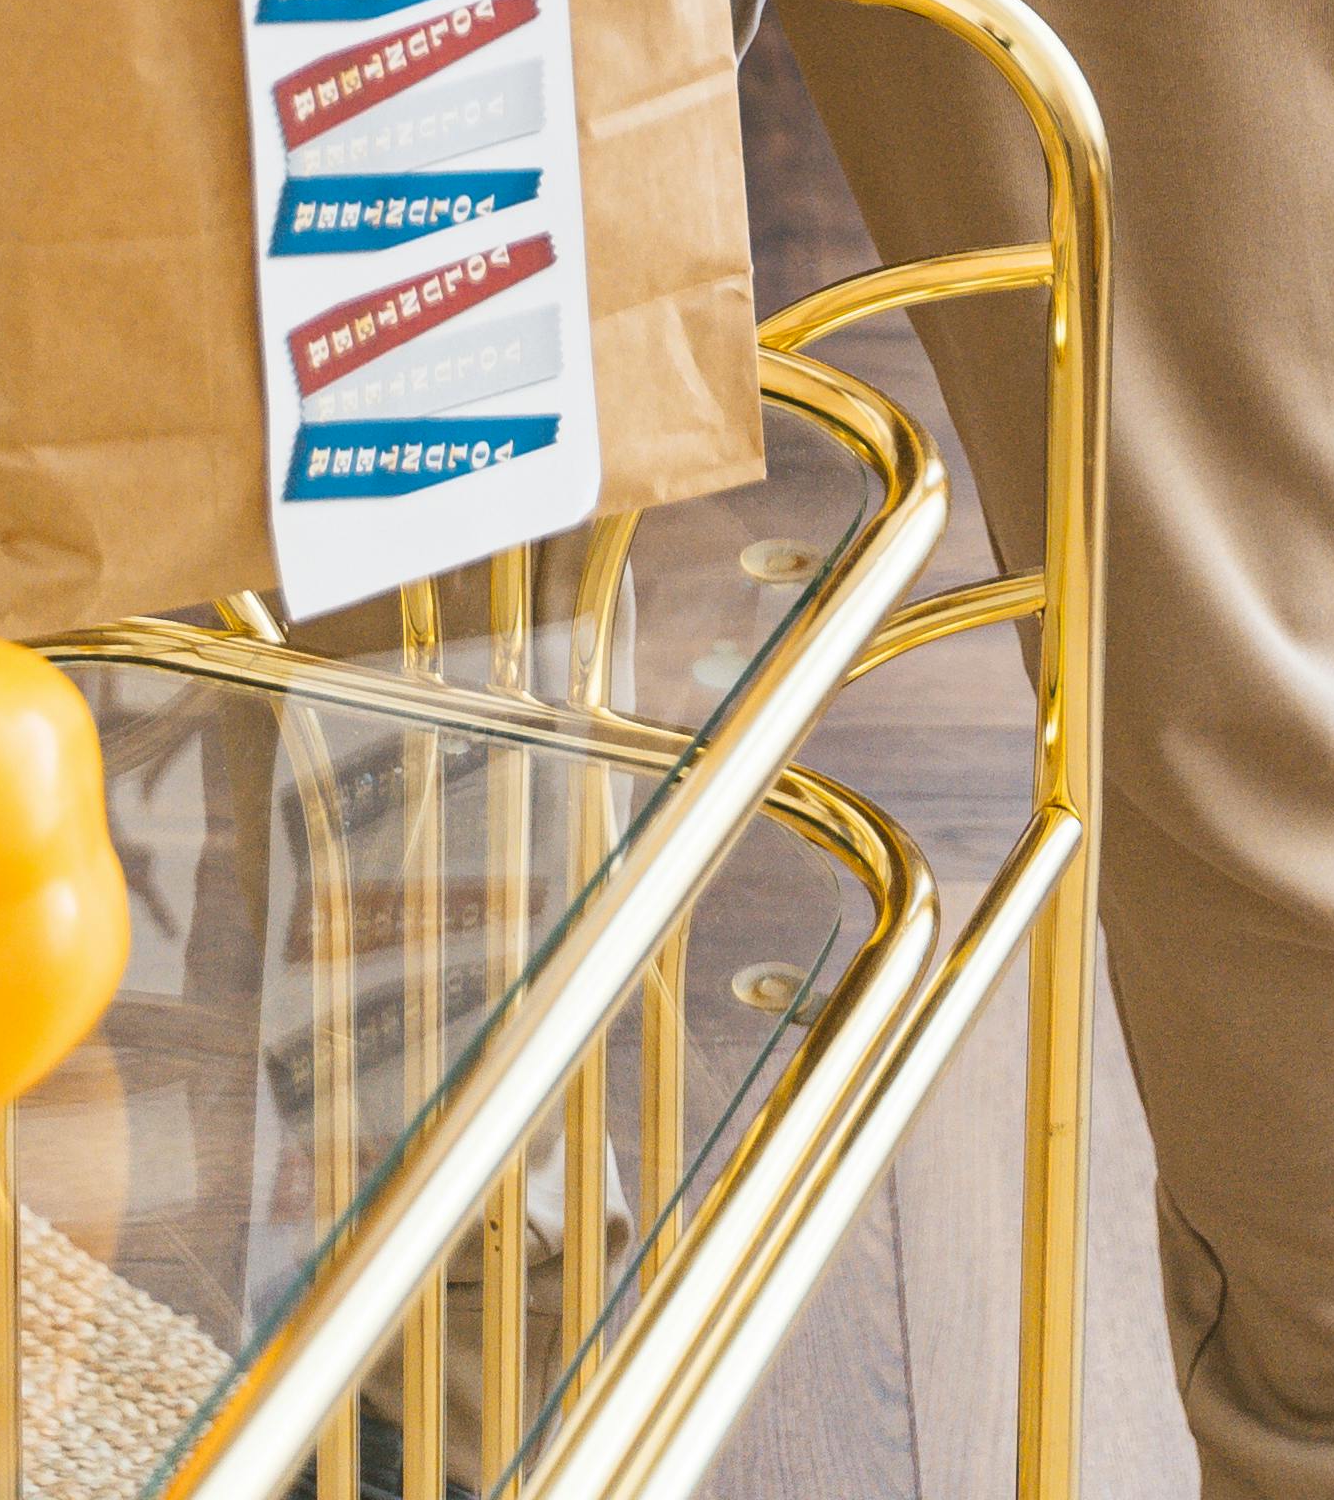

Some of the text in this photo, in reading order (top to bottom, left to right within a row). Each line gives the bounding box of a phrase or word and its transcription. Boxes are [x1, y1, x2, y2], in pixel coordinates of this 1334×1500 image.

[293, 194, 497, 233] VOLUNTEER
[306, 243, 513, 370] VOLUNTEER
[307, 439, 515, 479] VOLUNTEER
